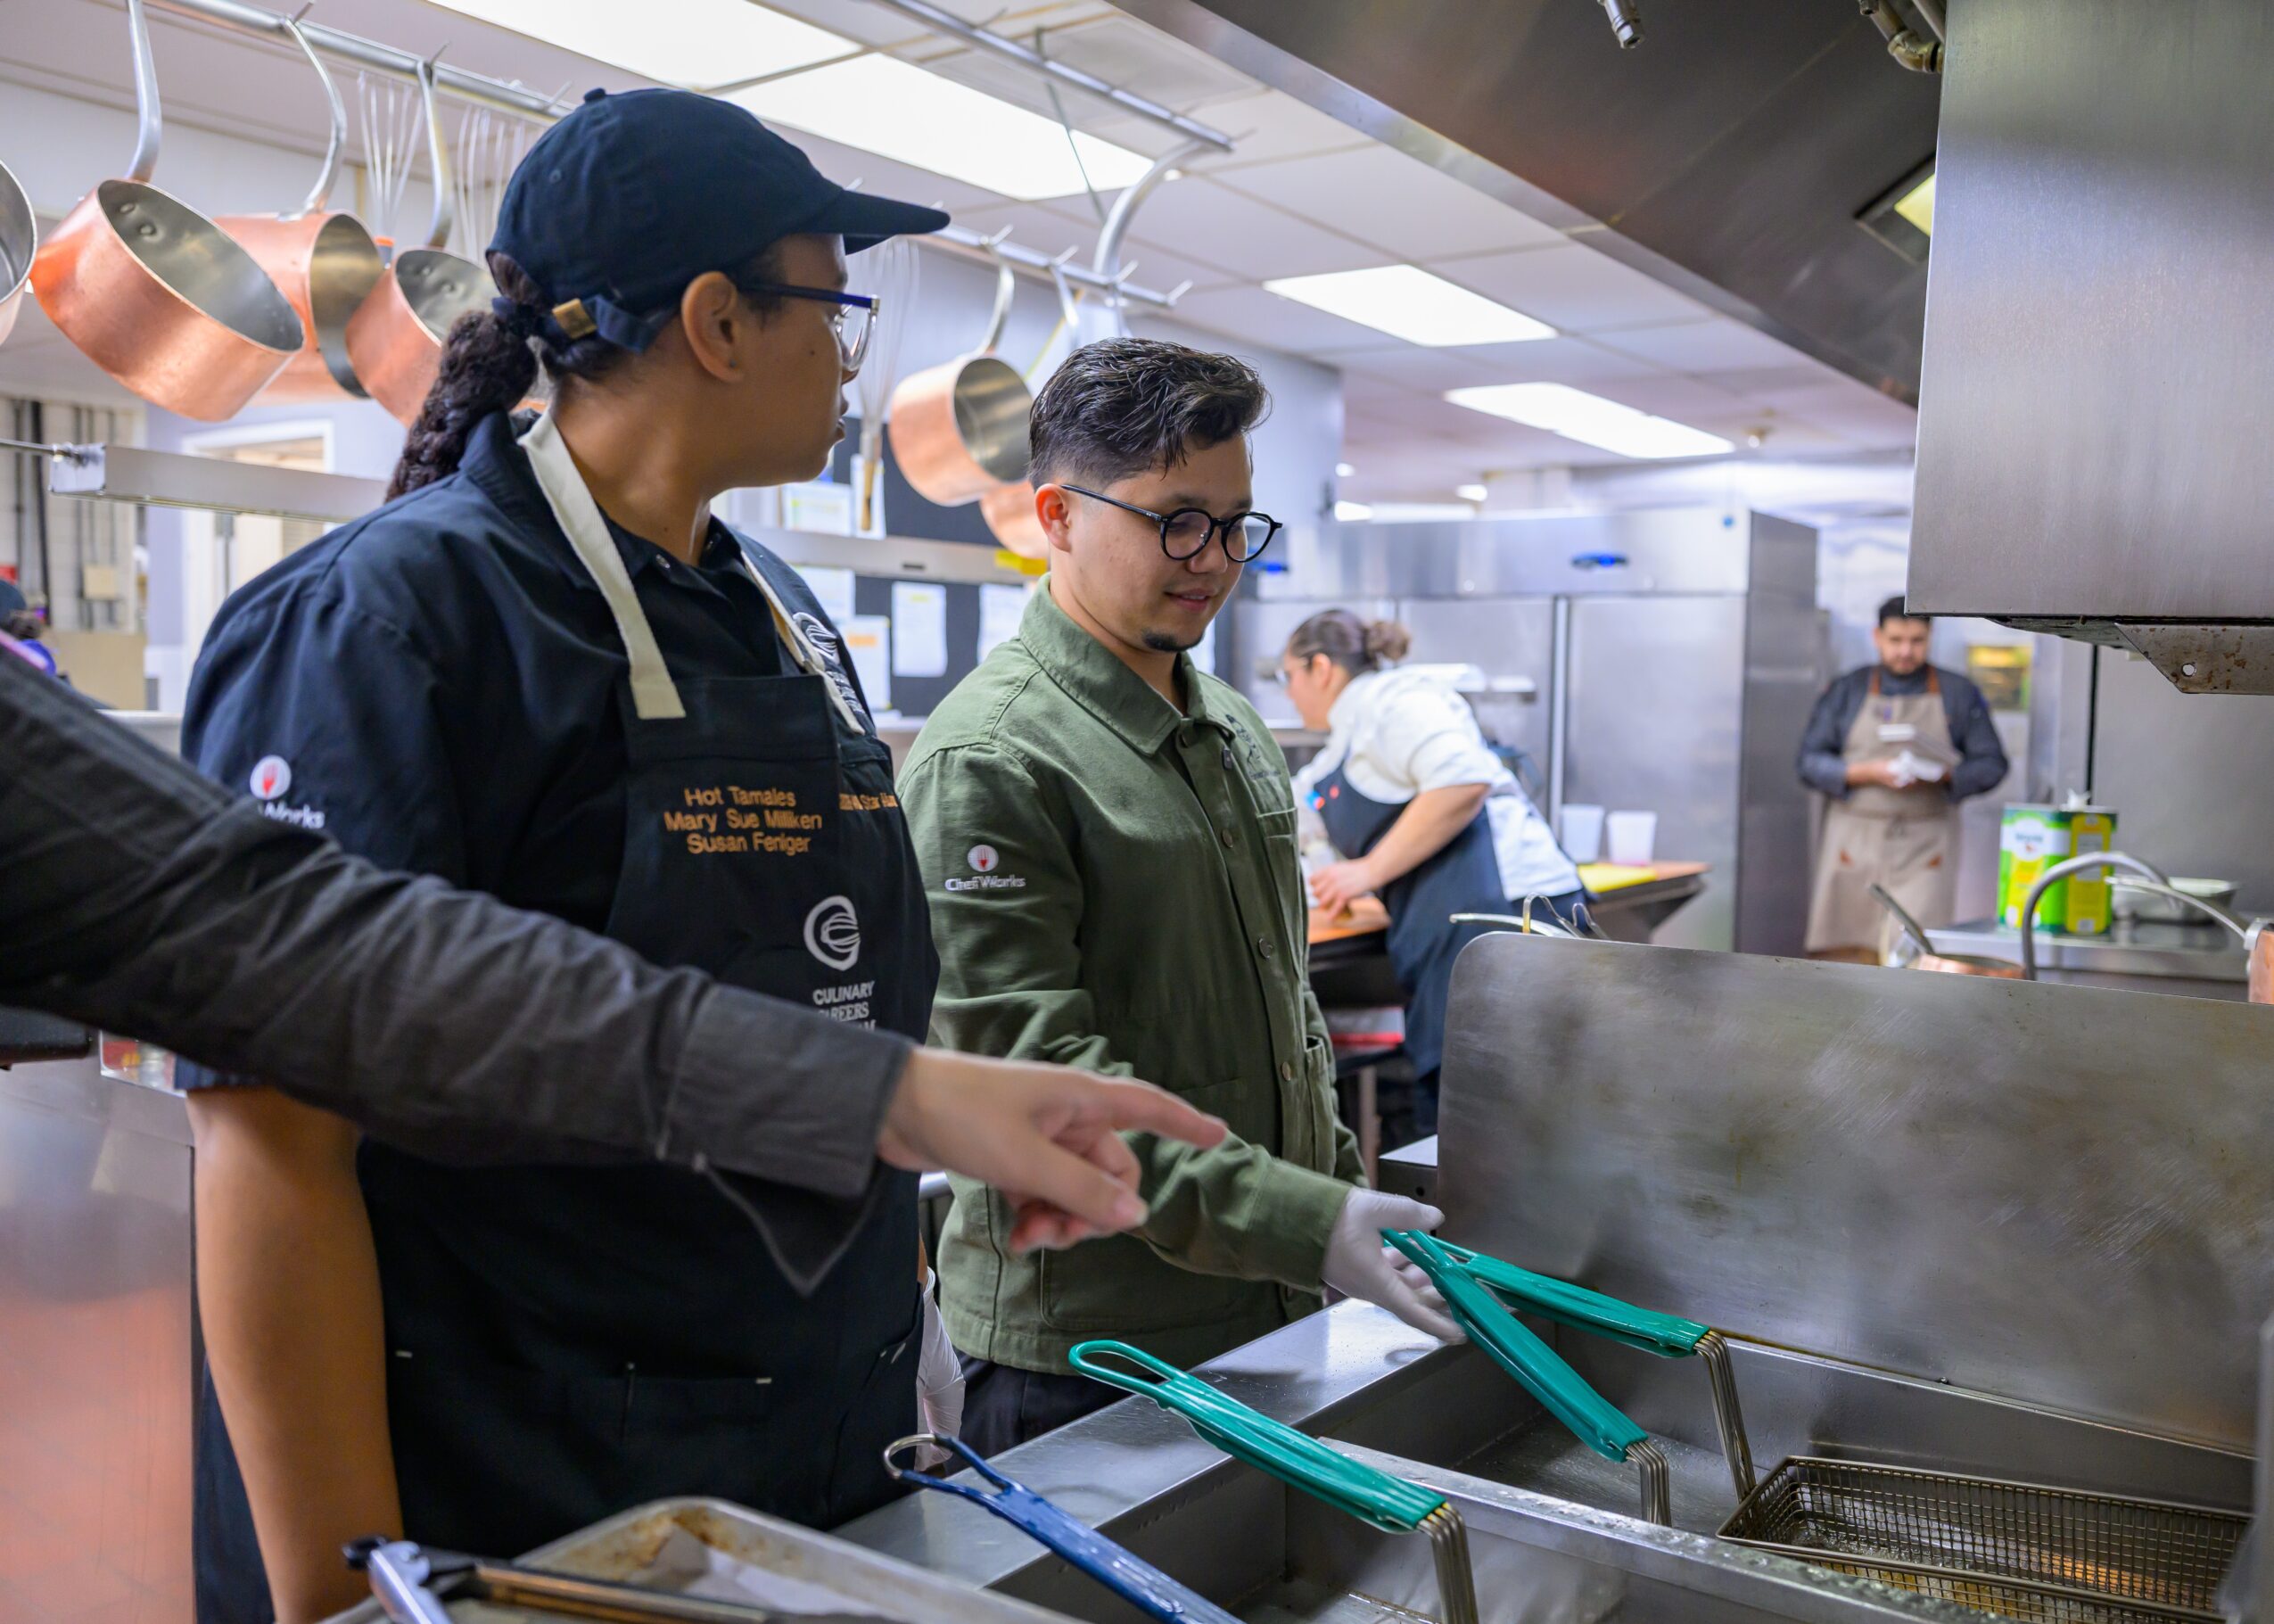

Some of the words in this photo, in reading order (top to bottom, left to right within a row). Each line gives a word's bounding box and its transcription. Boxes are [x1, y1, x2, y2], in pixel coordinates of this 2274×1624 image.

[684, 786, 724, 807] Hot
[727, 785, 796, 807] Tamales
[663, 811, 718, 833] Mary
[726, 808, 760, 829] Sue
[764, 810, 822, 830] Milliken
[687, 833, 748, 854] Susan
[752, 831, 812, 856] Feniger
[812, 979, 876, 1006] CULINARY
